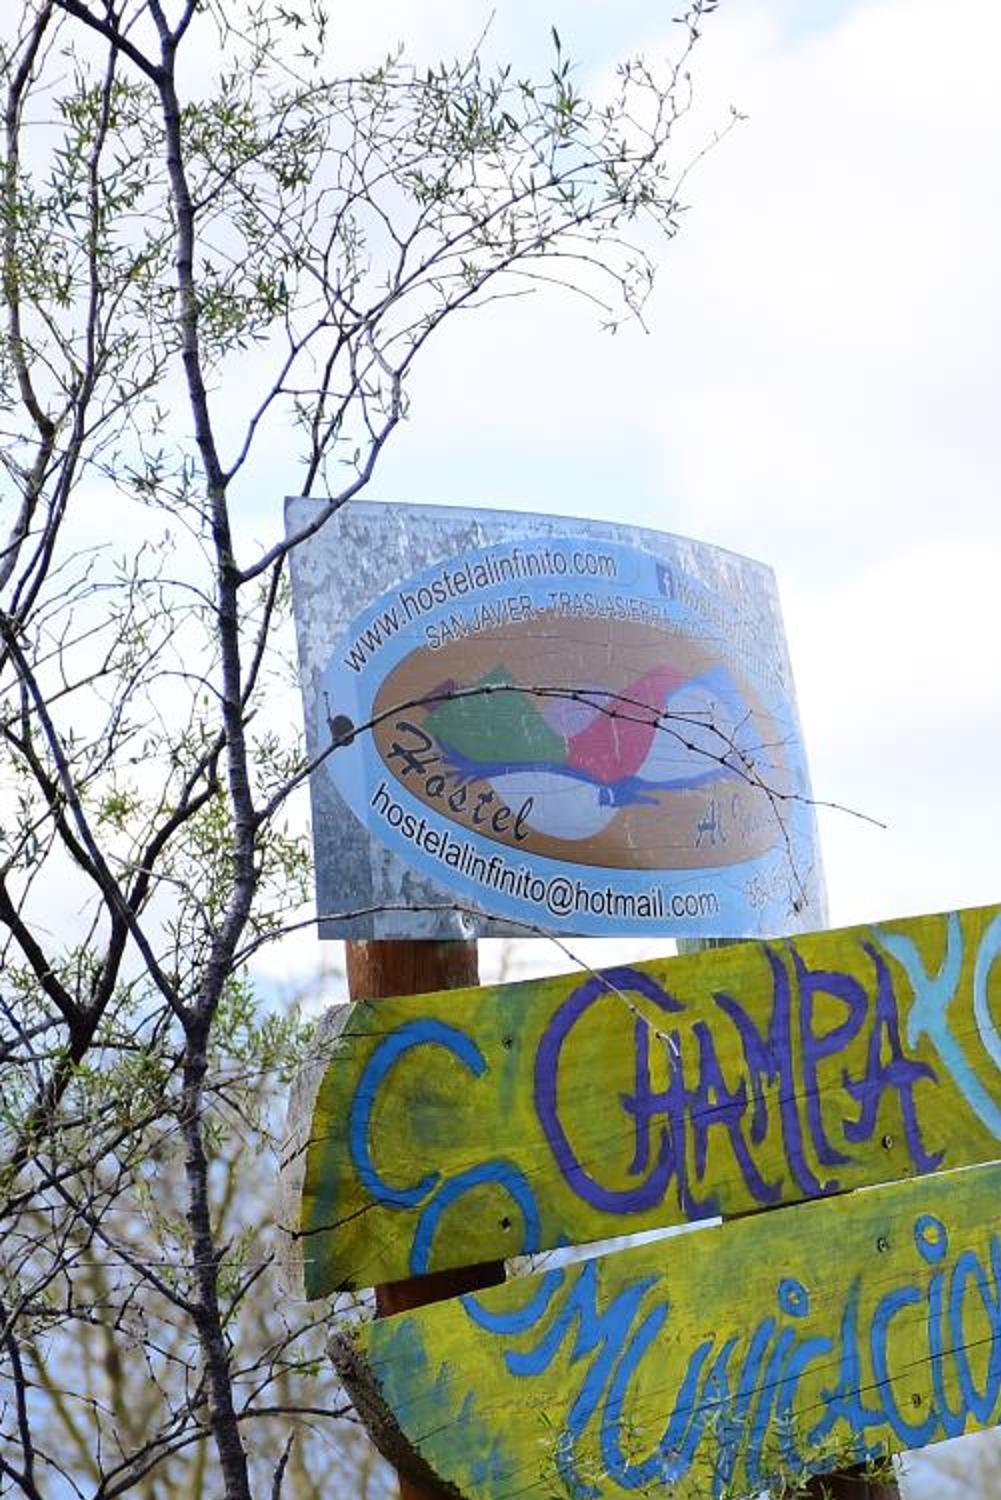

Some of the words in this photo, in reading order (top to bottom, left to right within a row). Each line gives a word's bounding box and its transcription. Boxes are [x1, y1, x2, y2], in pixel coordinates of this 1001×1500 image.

[344, 548, 618, 673] www.hostelalinfinito.com
[425, 613, 468, 648] SAN
[471, 595, 534, 631] JAVIER
[386, 721, 534, 842] Hostel
[370, 783, 720, 918] hostelalinfinito@hotmail.com
